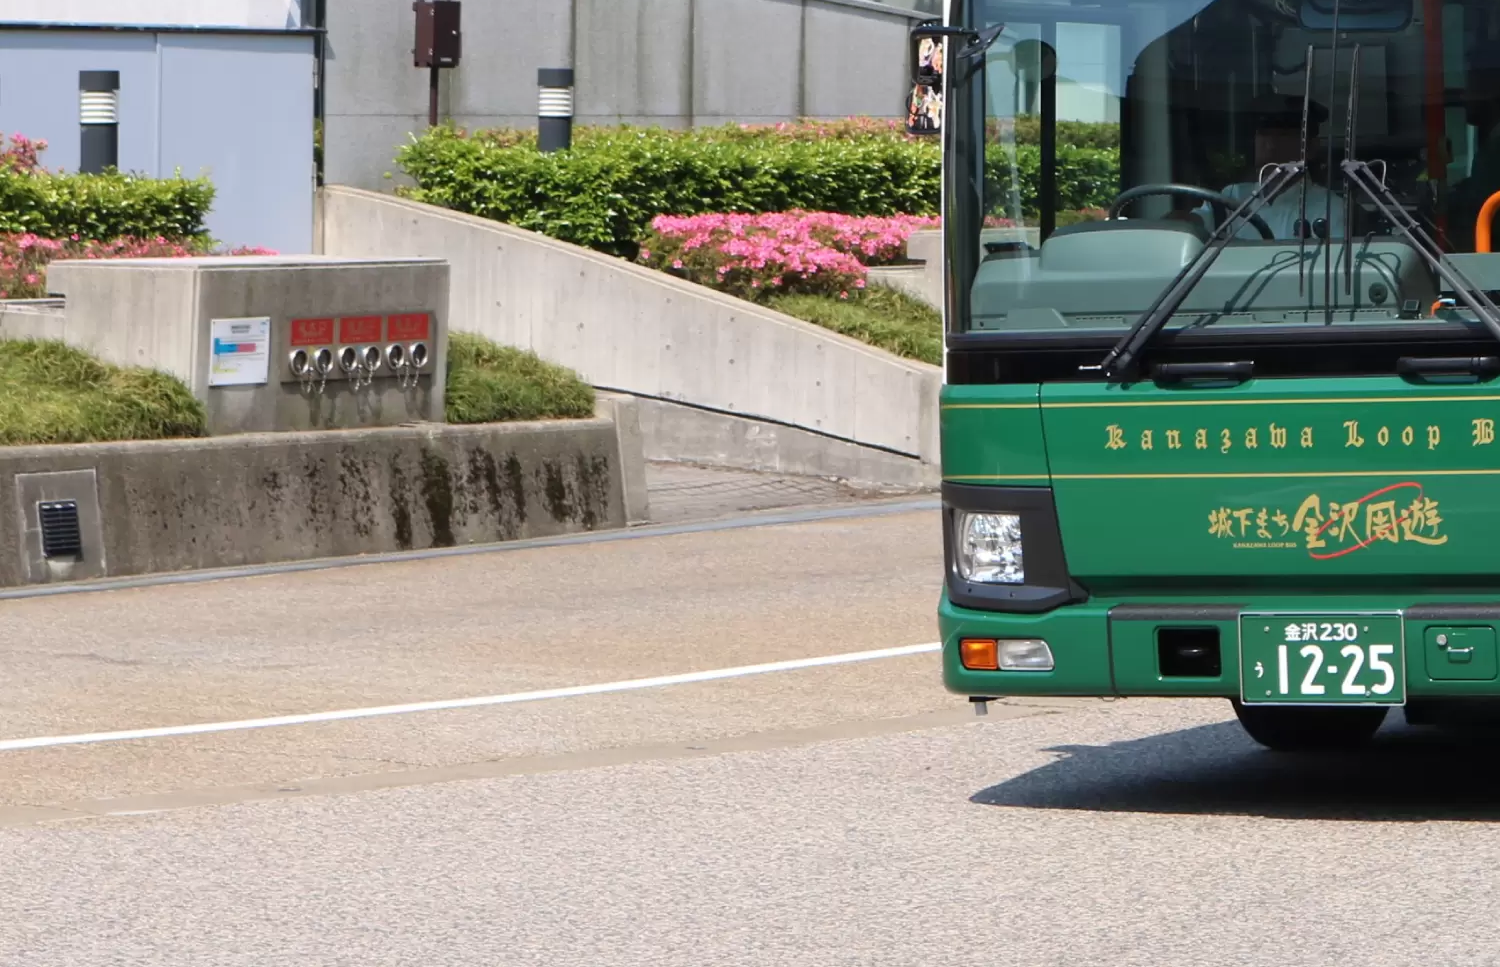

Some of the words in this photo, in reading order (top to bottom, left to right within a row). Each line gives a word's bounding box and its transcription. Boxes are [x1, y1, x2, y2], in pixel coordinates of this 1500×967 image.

[1104, 422, 1314, 454] Kanazawa
[1343, 419, 1442, 451] Loop
[1207, 493, 1449, 550] 城下まち金沢周遊
[1254, 661, 1264, 678] う
[1277, 644, 1396, 695] 12-25
